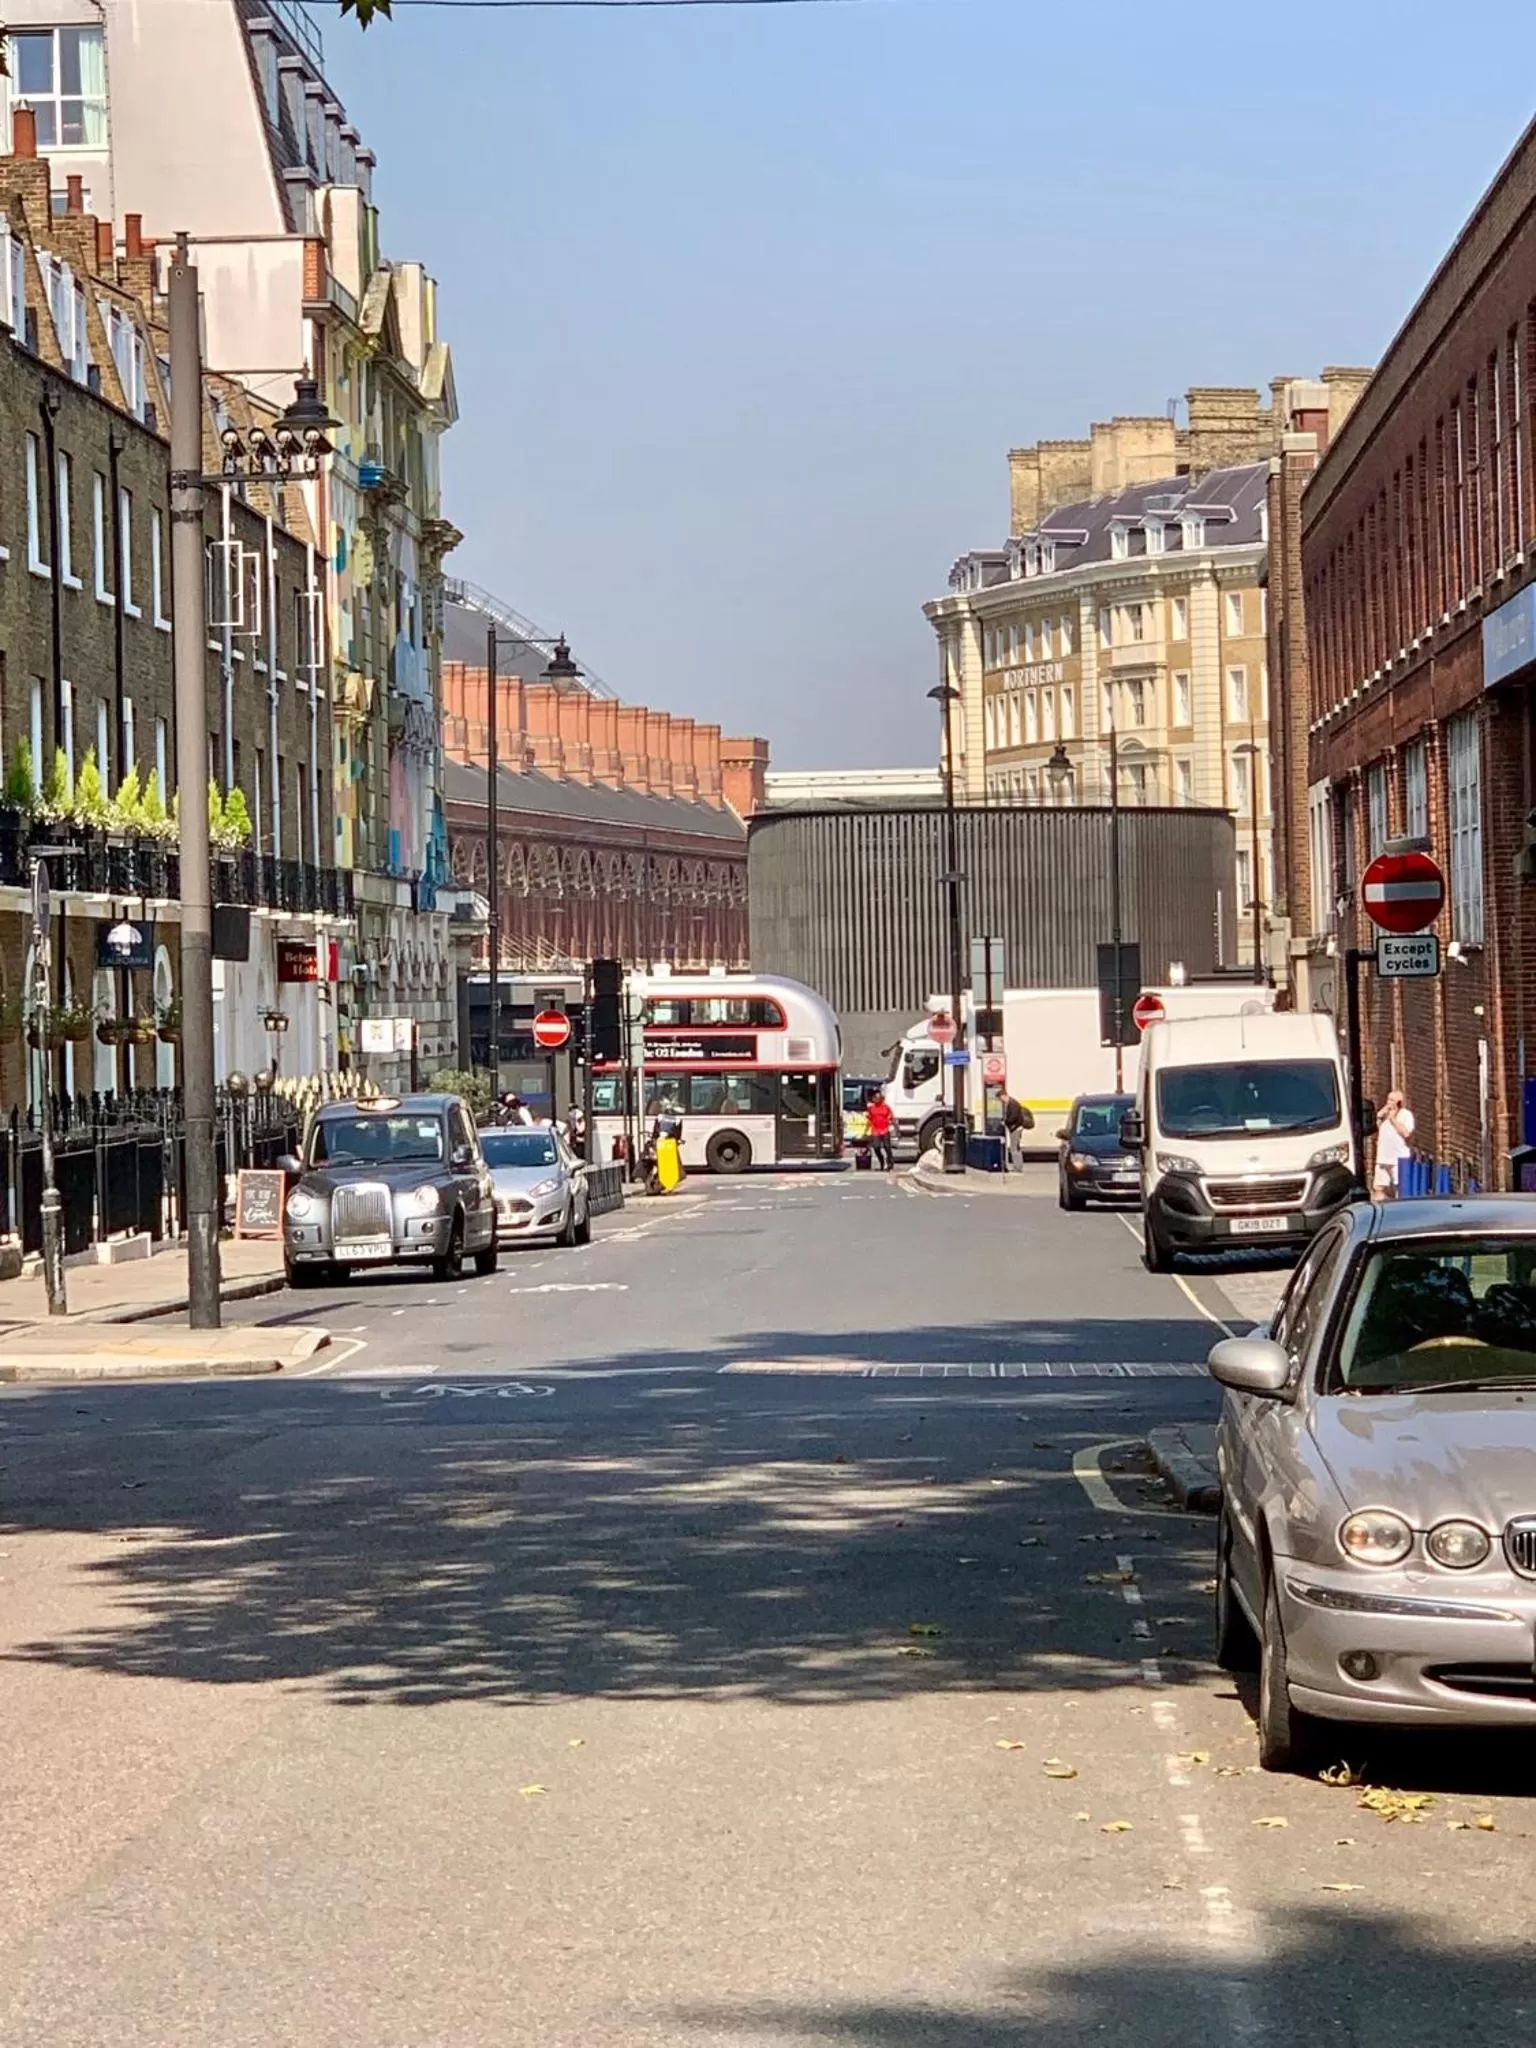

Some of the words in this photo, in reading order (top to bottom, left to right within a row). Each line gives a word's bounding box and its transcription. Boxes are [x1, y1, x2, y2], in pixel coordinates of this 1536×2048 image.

[1384, 943, 1433, 956] Except
[1386, 957, 1430, 971] cycles
[671, 1048, 704, 1058] London
